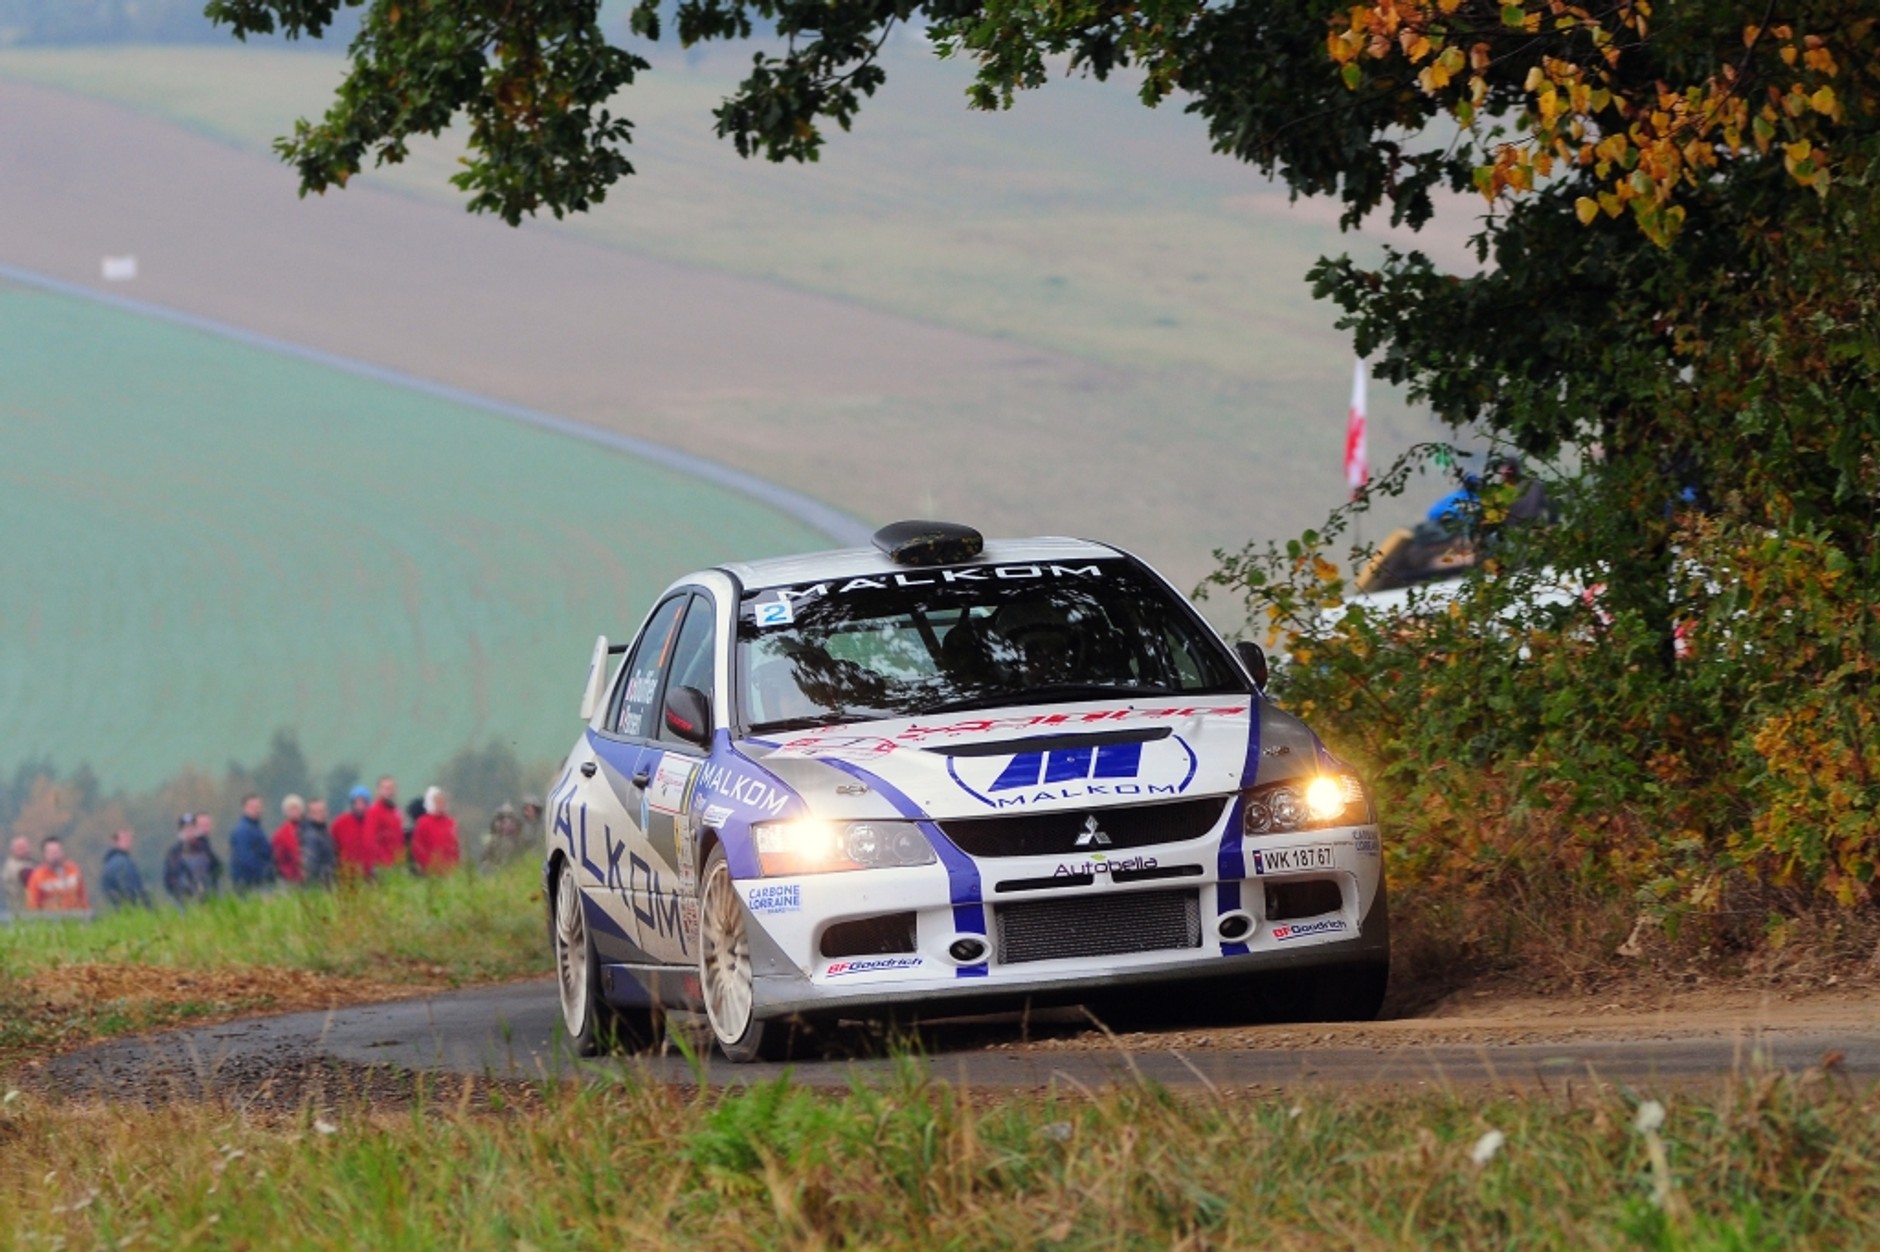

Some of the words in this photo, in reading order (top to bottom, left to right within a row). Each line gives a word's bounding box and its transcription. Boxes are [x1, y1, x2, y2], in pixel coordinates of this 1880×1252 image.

[777, 564, 1101, 602] MALKOM
[763, 604, 788, 623] 2
[700, 761, 790, 816] MALKOM
[998, 784, 1176, 808] MALKOM
[1054, 856, 1158, 876] Autobella
[1264, 851, 1291, 869] WK
[749, 884, 800, 899] CARBONE
[749, 896, 800, 910] LORRAINE
[1272, 919, 1347, 938] BFGoodrich
[826, 958, 923, 975] BFGoodrich
